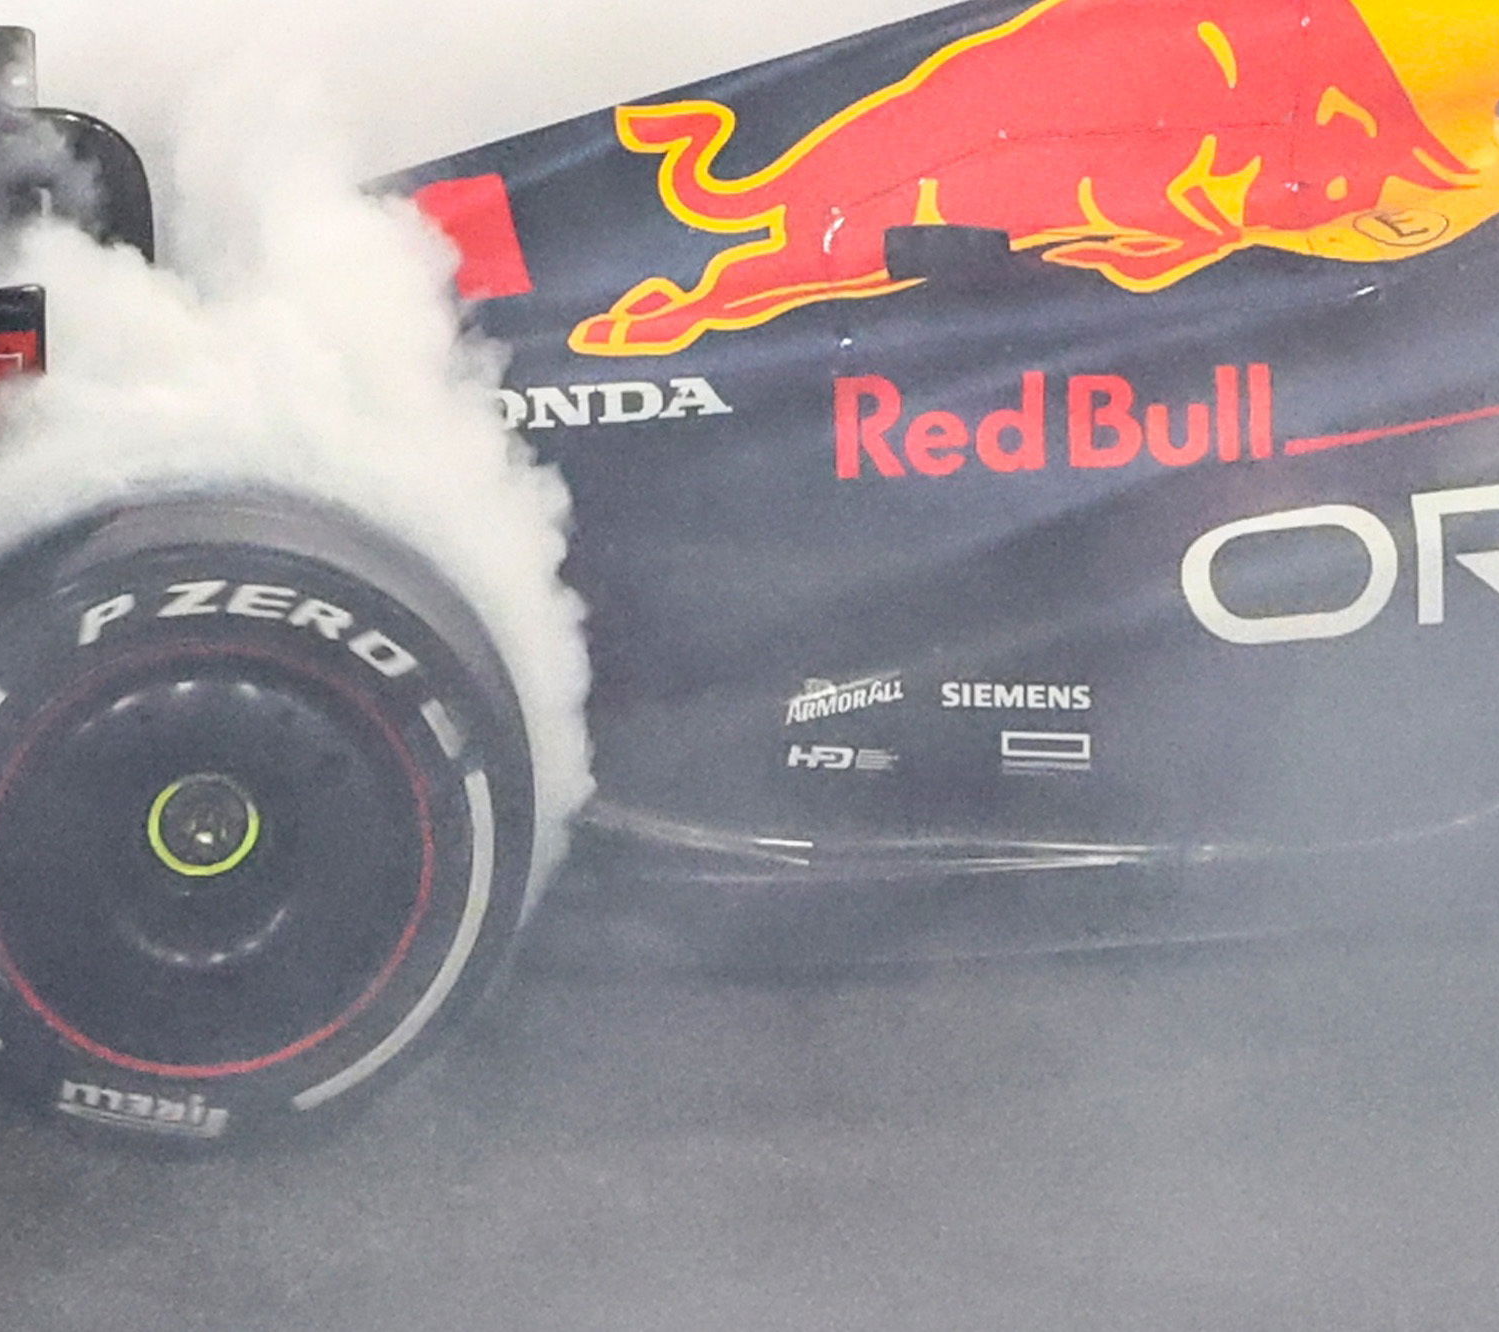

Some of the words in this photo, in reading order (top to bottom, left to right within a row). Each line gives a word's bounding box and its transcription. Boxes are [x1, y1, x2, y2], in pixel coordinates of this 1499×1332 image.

[497, 376, 734, 432] ONDA
[834, 368, 1046, 482] Red
[1066, 362, 1274, 471] Bull
[77, 592, 135, 647] P
[155, 579, 419, 678] ZERO
[941, 681, 1092, 711] SIEMENS
